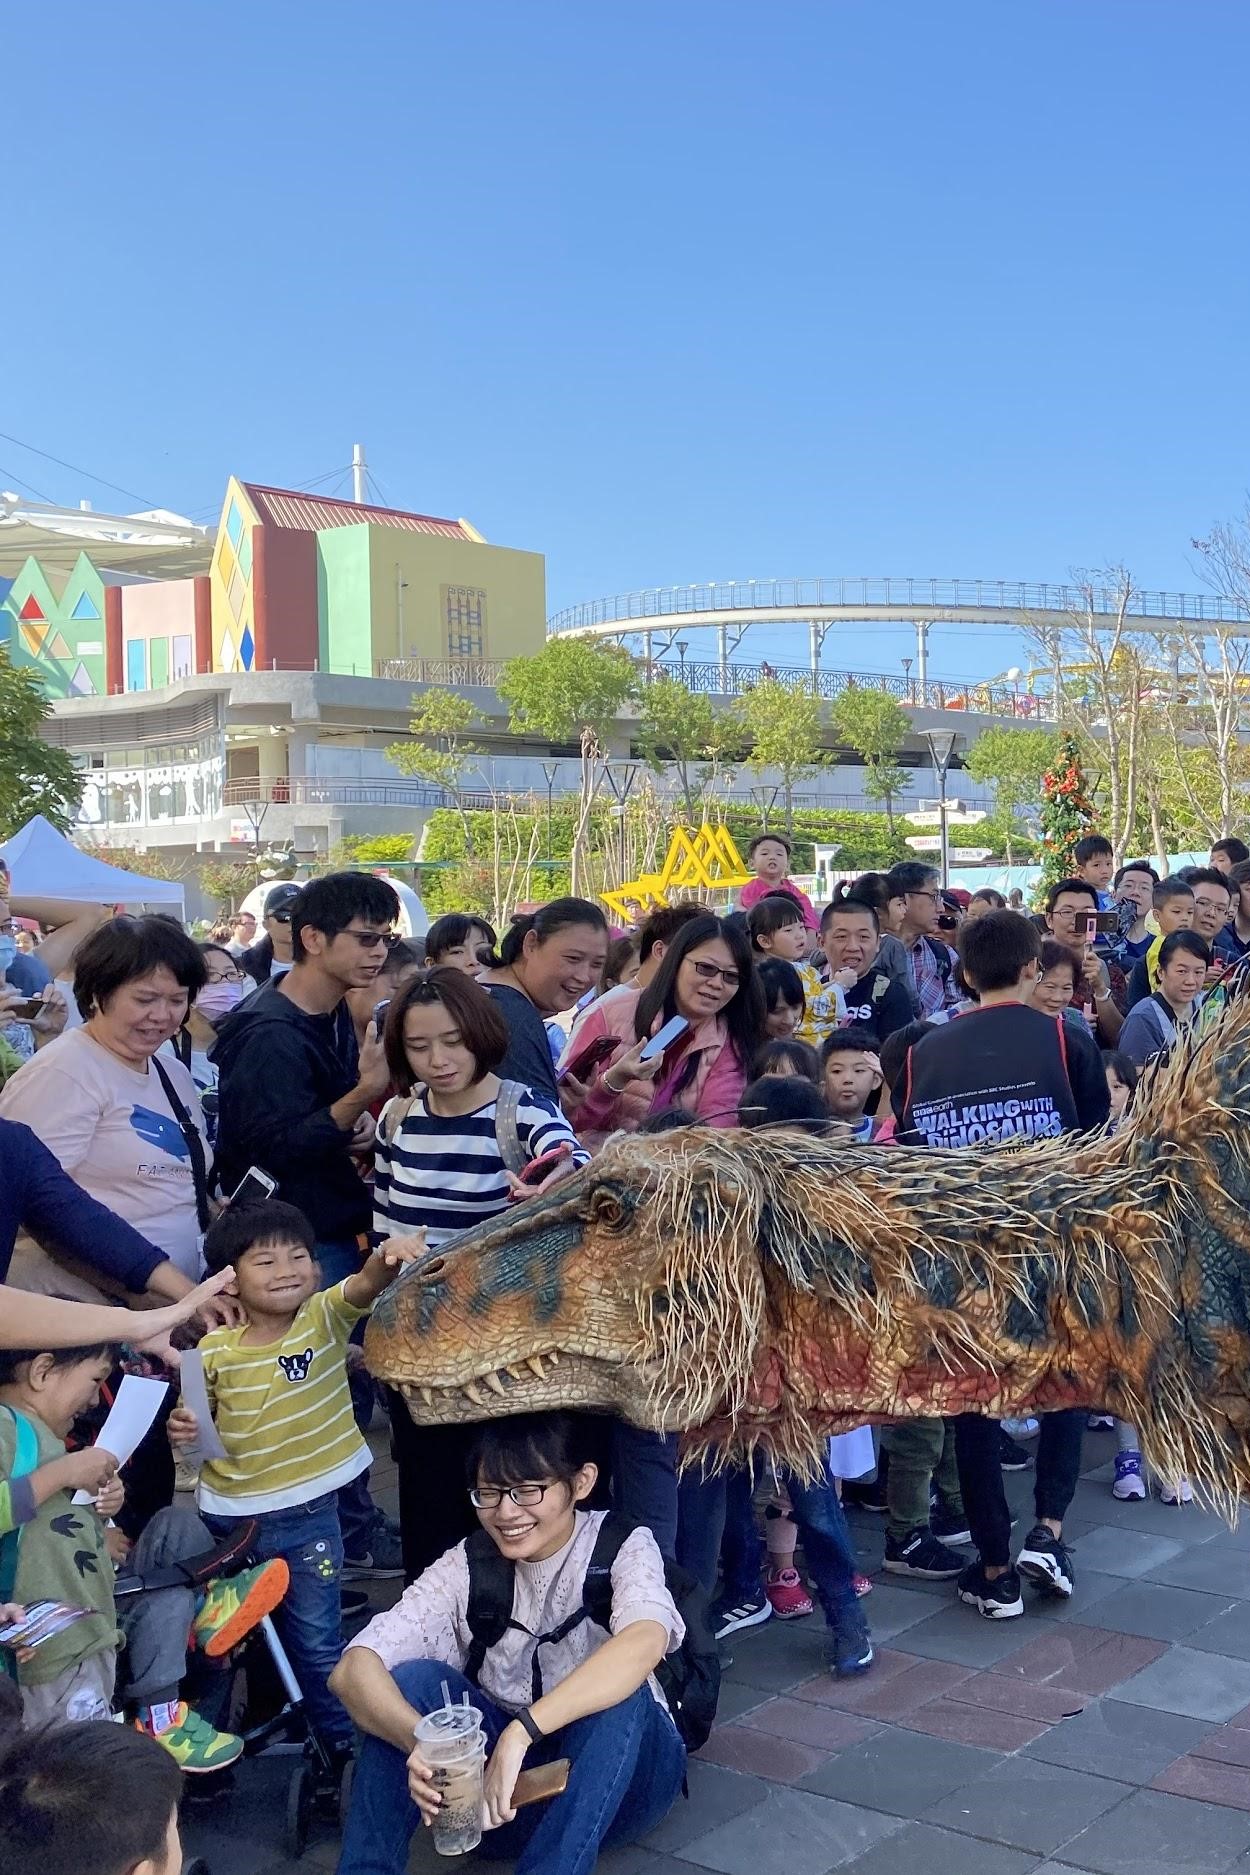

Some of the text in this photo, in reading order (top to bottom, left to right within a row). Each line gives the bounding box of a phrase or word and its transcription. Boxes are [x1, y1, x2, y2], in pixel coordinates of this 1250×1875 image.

[914, 1097, 1053, 1135] WALKING WITH
[933, 1101, 953, 1113] earth
